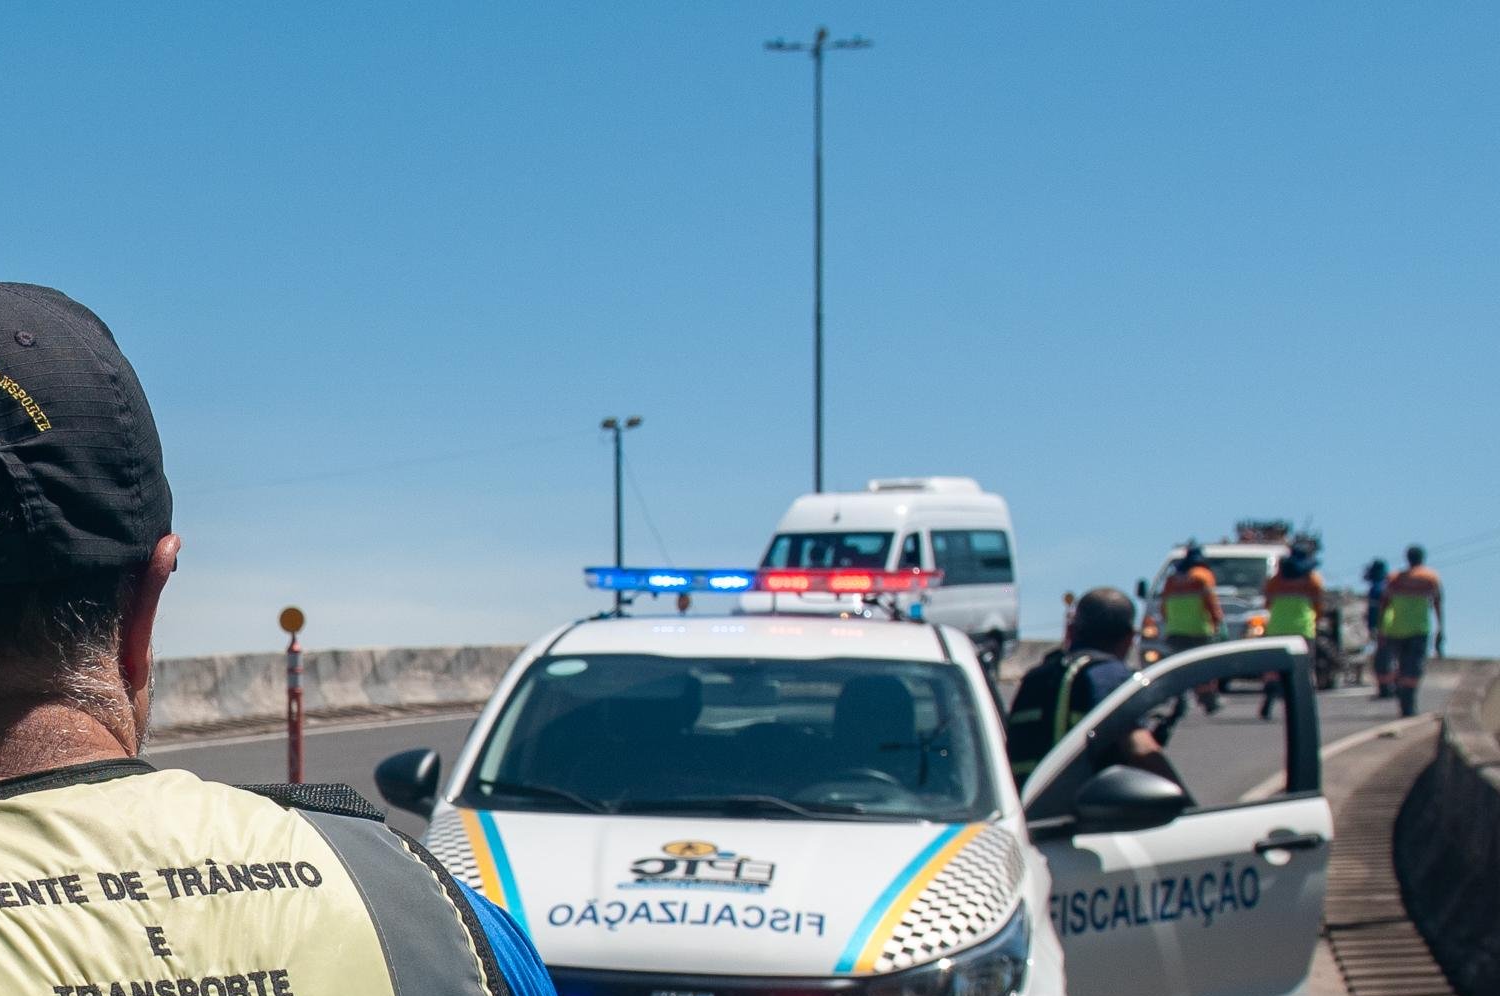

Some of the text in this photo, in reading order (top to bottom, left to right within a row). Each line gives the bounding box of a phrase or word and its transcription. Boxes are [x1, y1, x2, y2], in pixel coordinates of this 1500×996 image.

[97, 870, 148, 901] DE
[158, 858, 323, 898] TRÂNSITO
[146, 926, 172, 957] E
